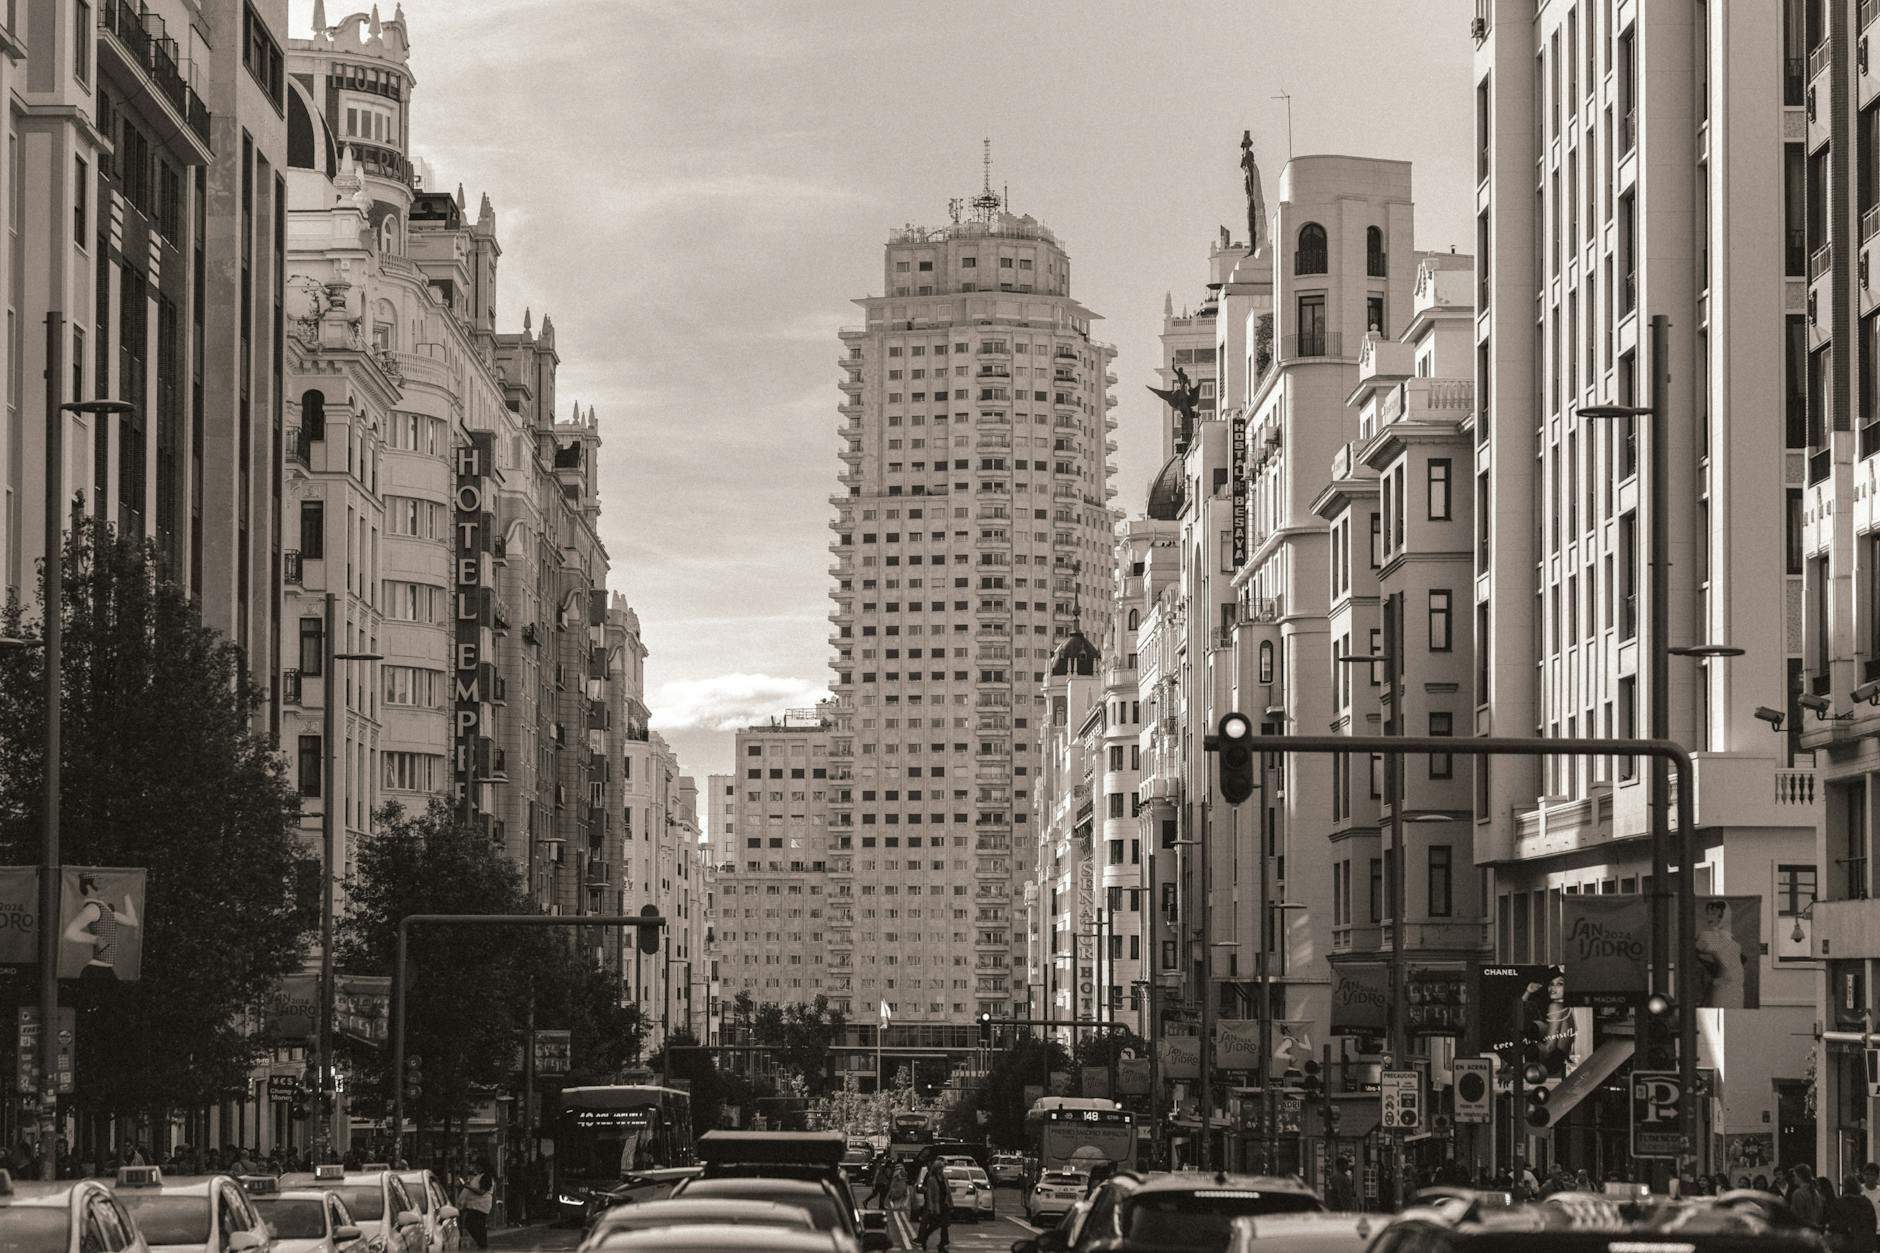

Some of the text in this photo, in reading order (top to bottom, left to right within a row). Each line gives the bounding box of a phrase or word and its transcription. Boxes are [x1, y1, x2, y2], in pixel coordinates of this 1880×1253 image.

[1234, 423, 1245, 476] HOSTAL
[456, 448, 481, 620] HOTEL
[1234, 496, 1245, 559] BESAYA
[1079, 862, 1093, 960] SENATOR
[1568, 917, 1631, 941] SAN 2024
[1580, 937, 1643, 960] ISIDRO
[1484, 968, 1518, 976] CHANEL
[1335, 977, 1359, 994] SAN
[1343, 990, 1385, 1007] ISIDRO
[1593, 995, 1626, 1003] MADRID
[1218, 1031, 1237, 1043] SAN
[1224, 1041, 1257, 1054] ISIDRO
[271, 1094, 293, 1102] Money
[1641, 1081, 1680, 1123] P
[1083, 1111, 1099, 1121] 148
